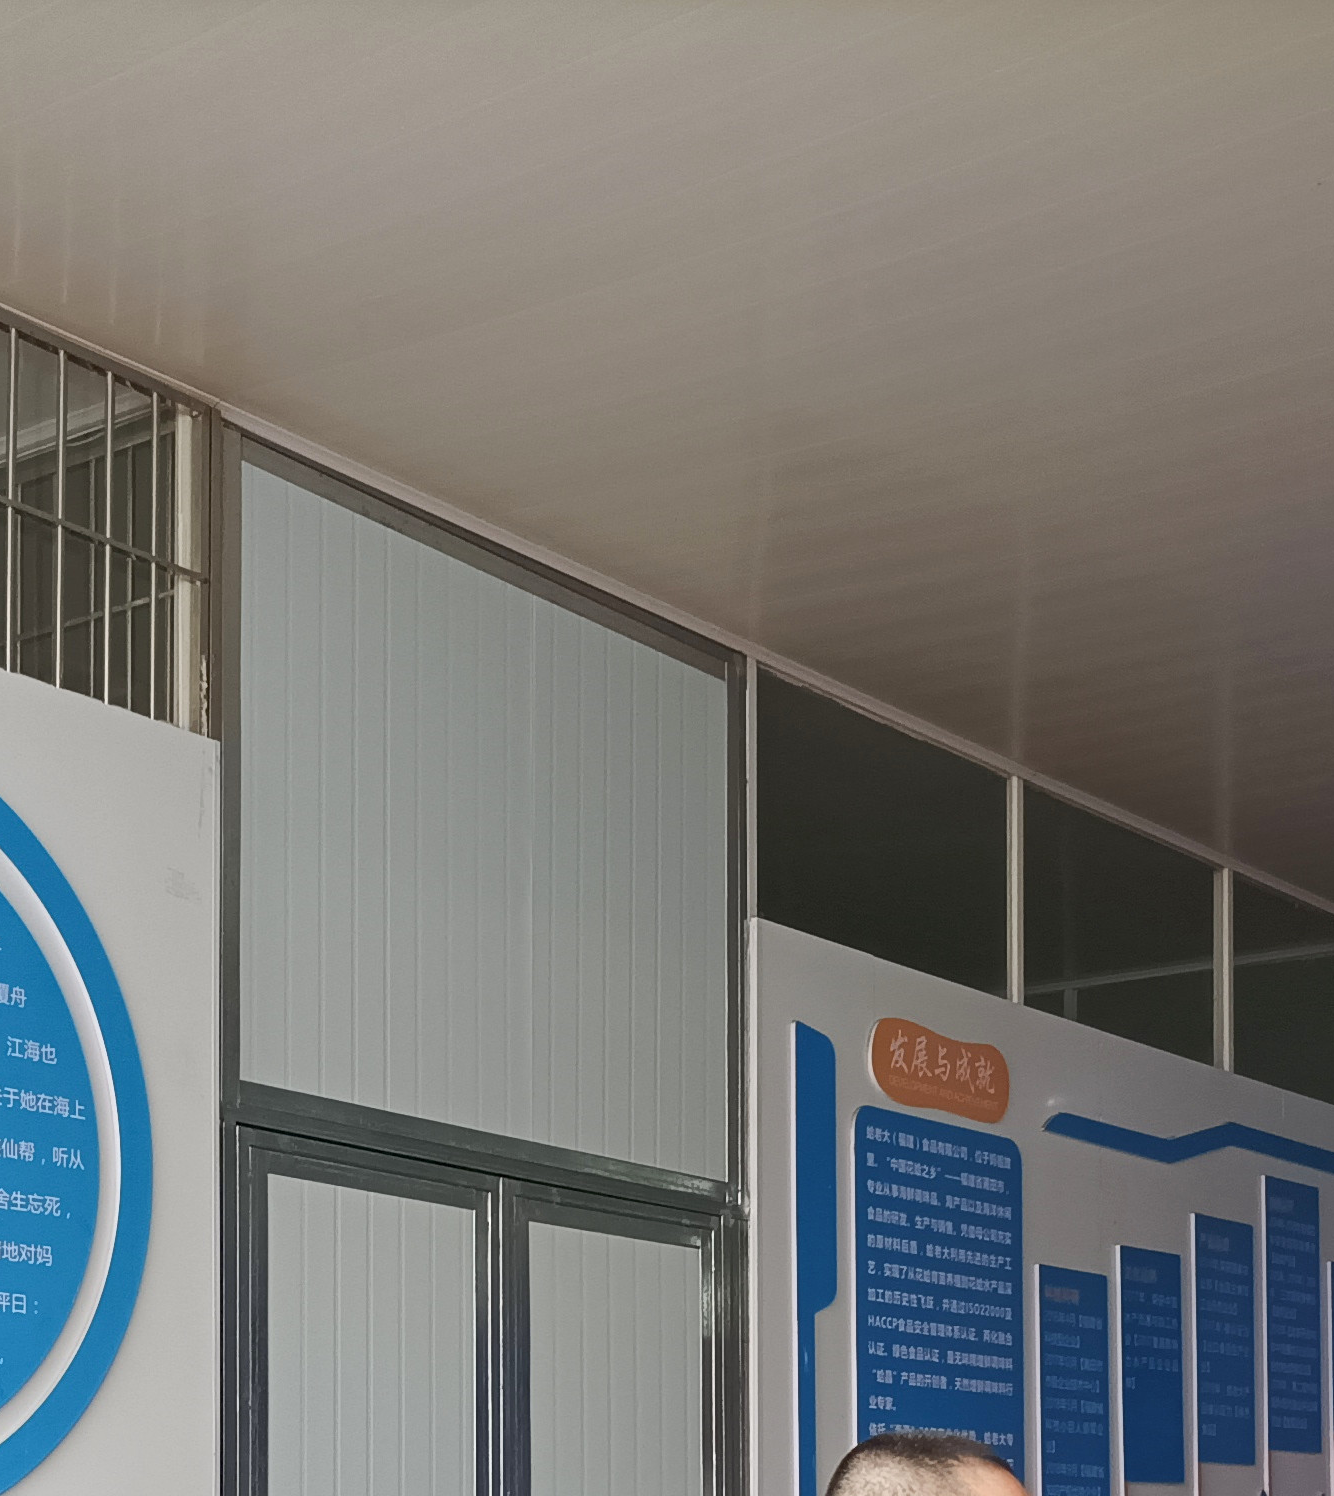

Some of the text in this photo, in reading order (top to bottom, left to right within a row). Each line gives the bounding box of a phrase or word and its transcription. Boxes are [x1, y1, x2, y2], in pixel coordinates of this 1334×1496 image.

[889, 1029, 996, 1095] 发展与成就
